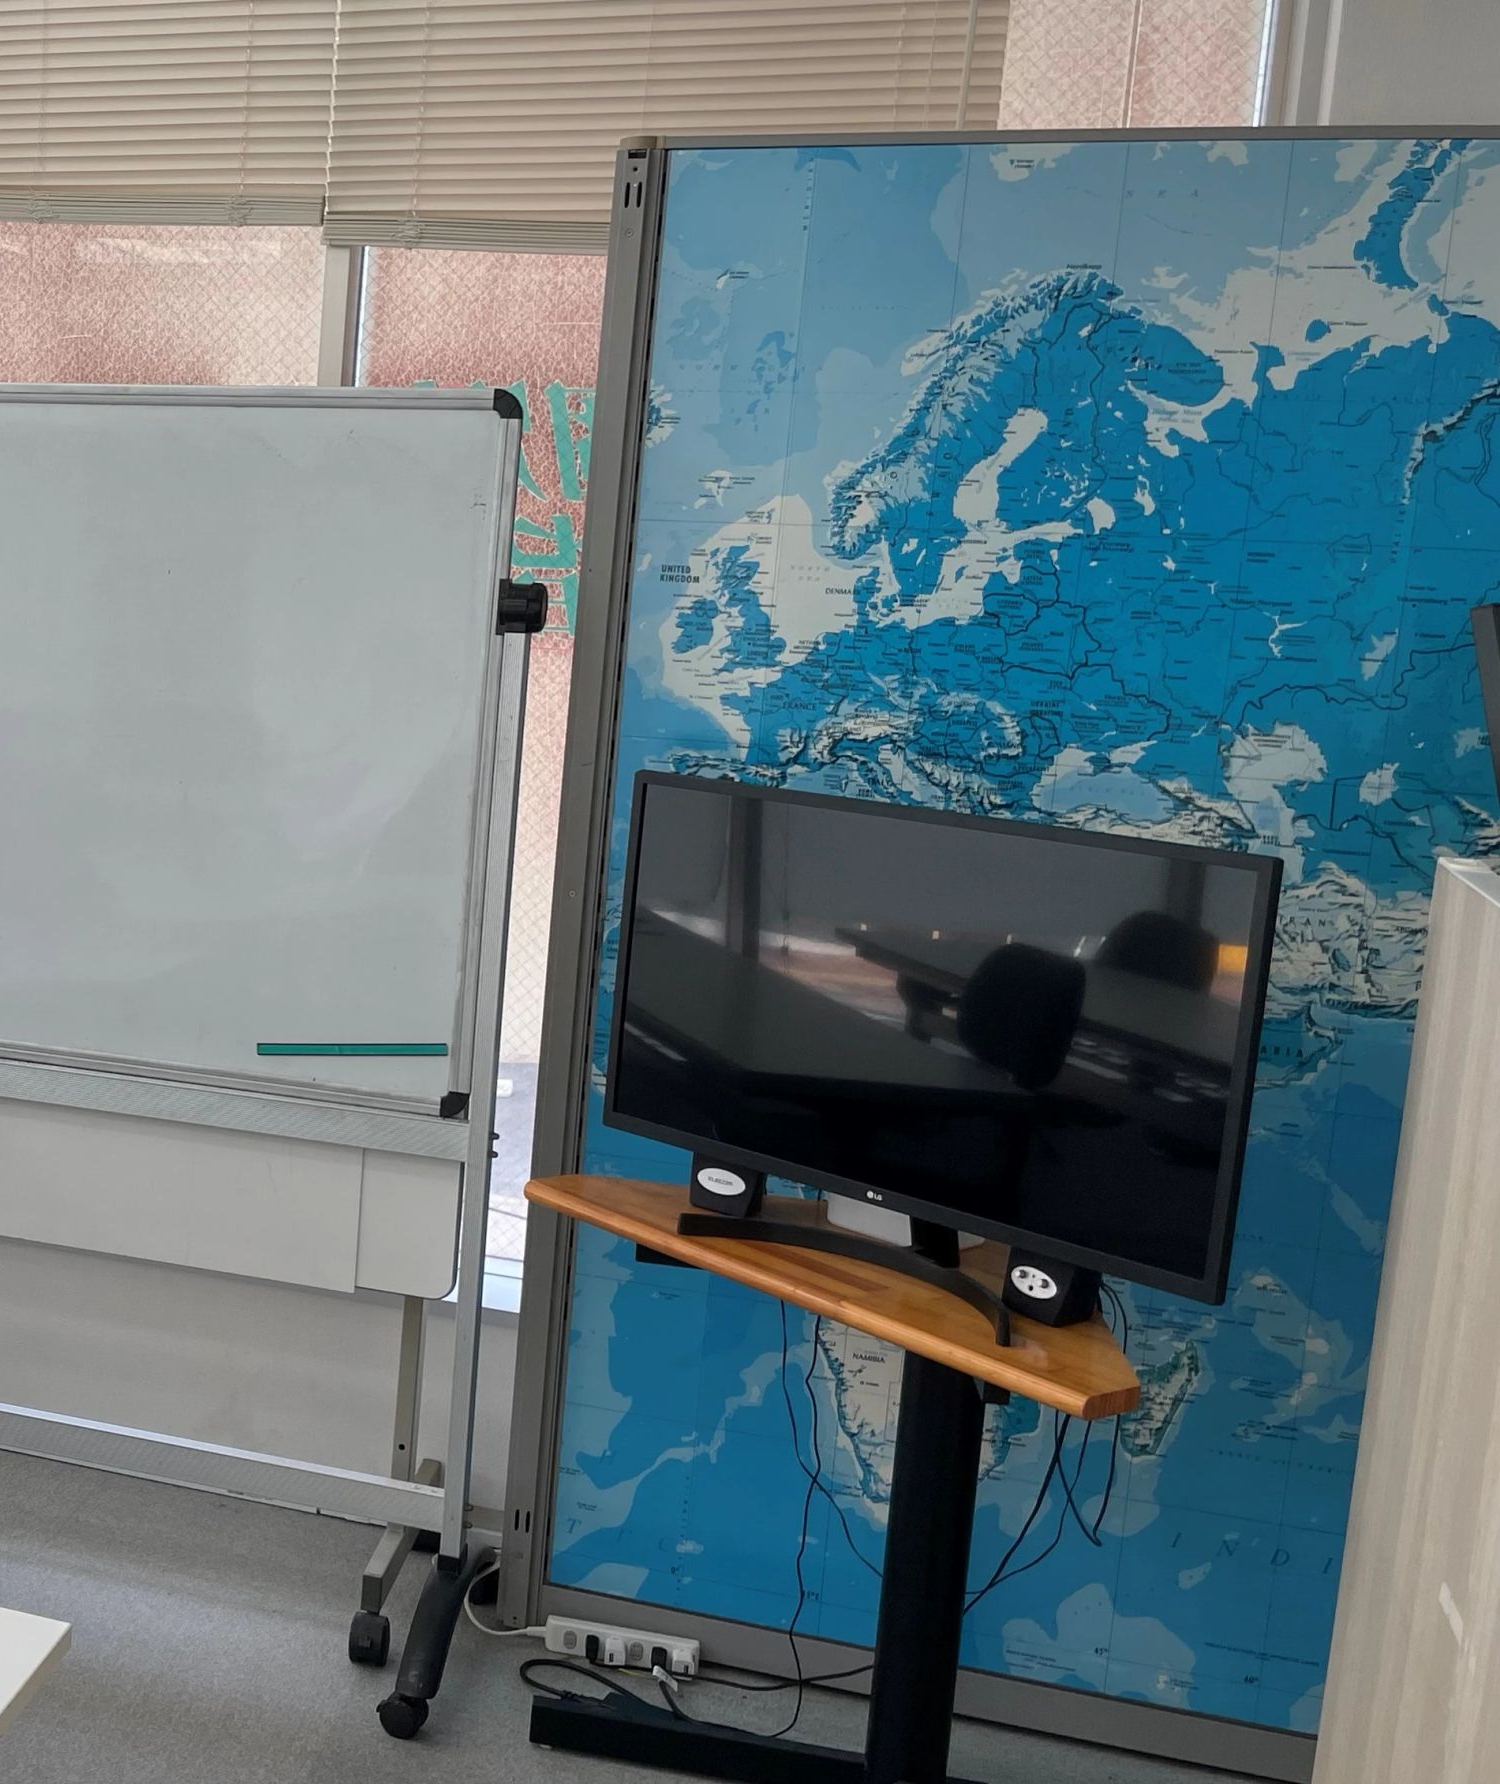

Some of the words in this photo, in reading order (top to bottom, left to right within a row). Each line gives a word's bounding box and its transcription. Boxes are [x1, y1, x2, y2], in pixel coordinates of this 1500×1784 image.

[661, 564, 691, 574] UNITED
[660, 574, 700, 583] KINGDOM
[783, 701, 816, 710] FRANCE
[852, 1352, 886, 1364] NAMIBIA
